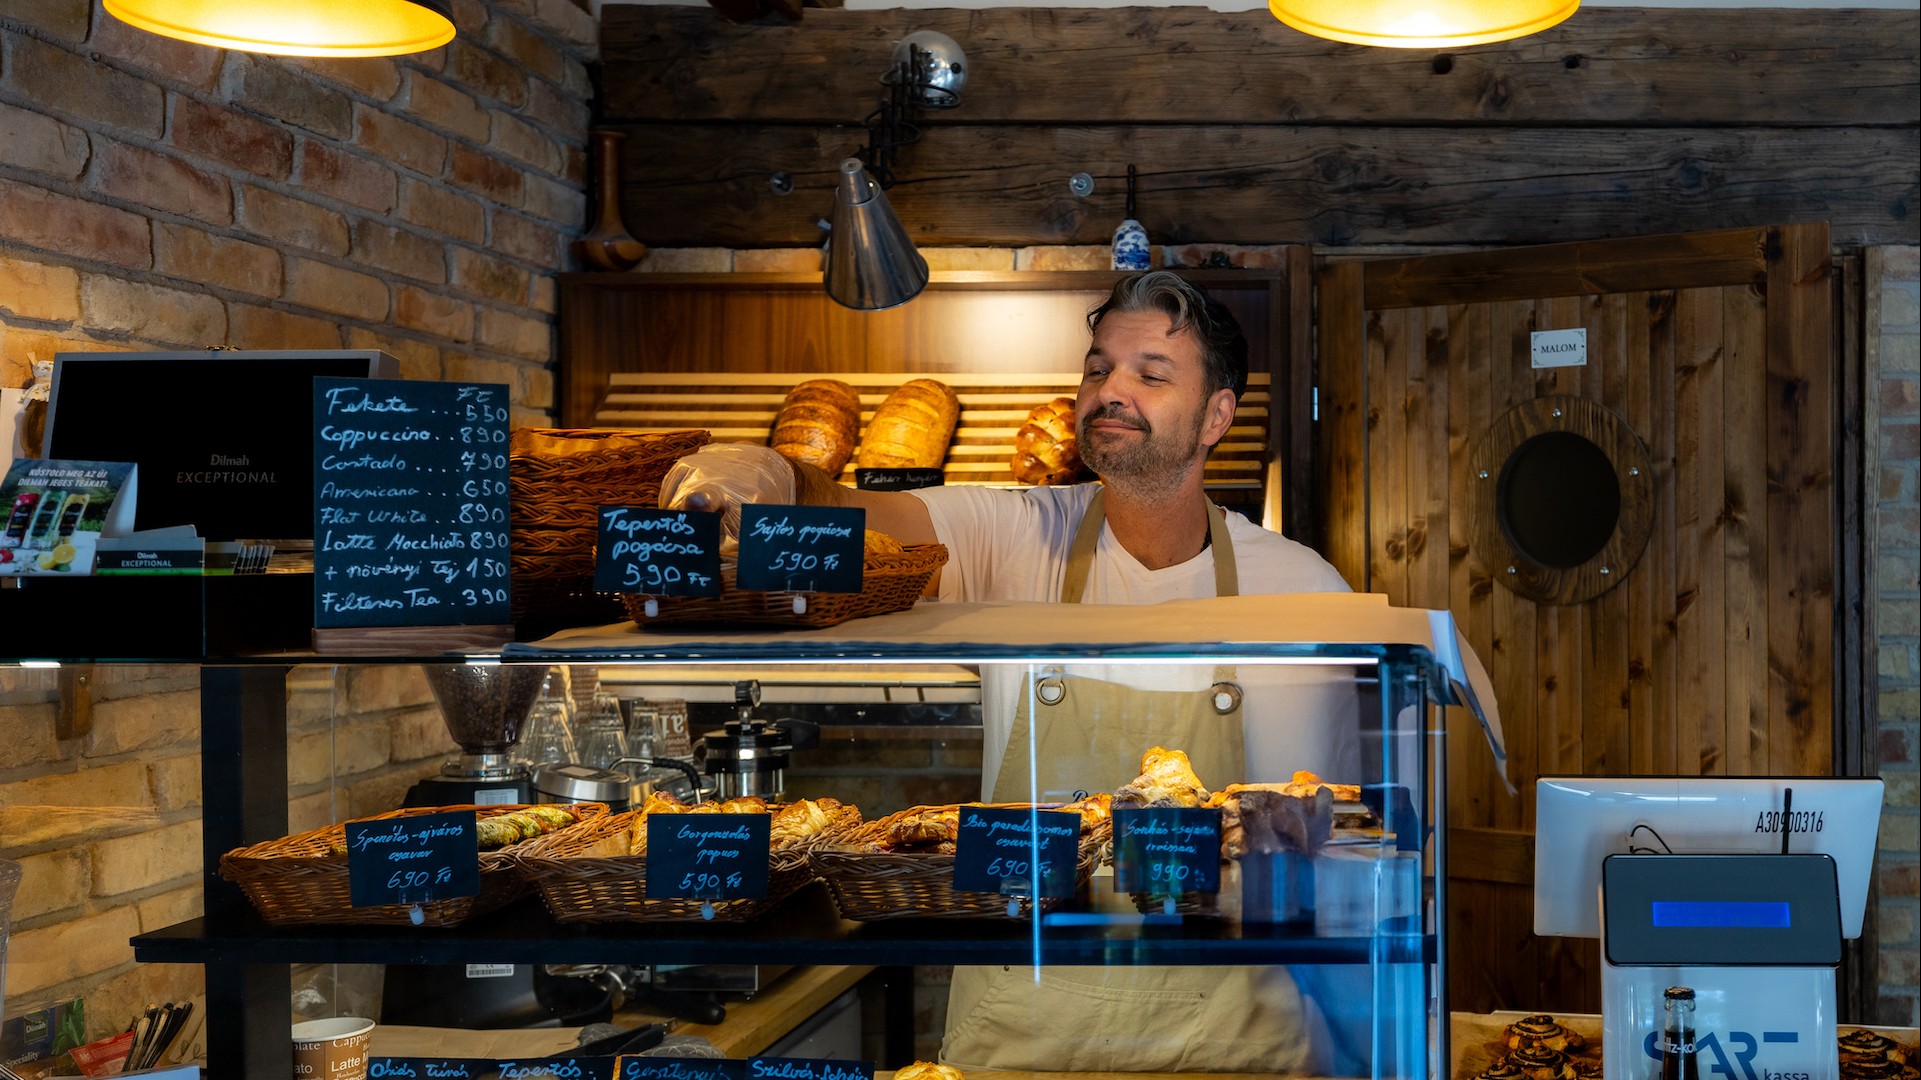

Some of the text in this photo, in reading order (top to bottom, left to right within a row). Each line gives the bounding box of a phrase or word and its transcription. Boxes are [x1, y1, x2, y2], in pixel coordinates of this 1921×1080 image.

[1541, 343, 1577, 354] MALOM
[325, 387, 508, 422] Fekete 550
[459, 427, 506, 444] 890
[210, 454, 250, 466] Dilmah
[461, 451, 507, 472] 790
[18, 479, 48, 487] DILMAH
[66, 469, 84, 477] MEG
[84, 470, 97, 478] AZ
[177, 472, 277, 483] EXCEPTIONAL
[320, 479, 507, 499] Americano 650
[320, 507, 362, 525] Flat
[459, 503, 506, 524] 890
[750, 516, 795, 543] Sajtos
[322, 530, 377, 552] Latte
[469, 531, 509, 550] 890
[466, 557, 507, 578] 150
[768, 551, 818, 571] 590
[622, 563, 681, 586] 590
[403, 588, 441, 606] Tea
[462, 589, 507, 606] 390
[962, 814, 988, 828] Bio
[1755, 811, 1823, 833] A30900316
[987, 858, 1029, 877] 690
[1152, 862, 1190, 881] 990
[387, 870, 429, 889] 690
[679, 872, 720, 891] 590
[331, 1057, 361, 1072] Latte
[1764, 1069, 1809, 1080] kassa
